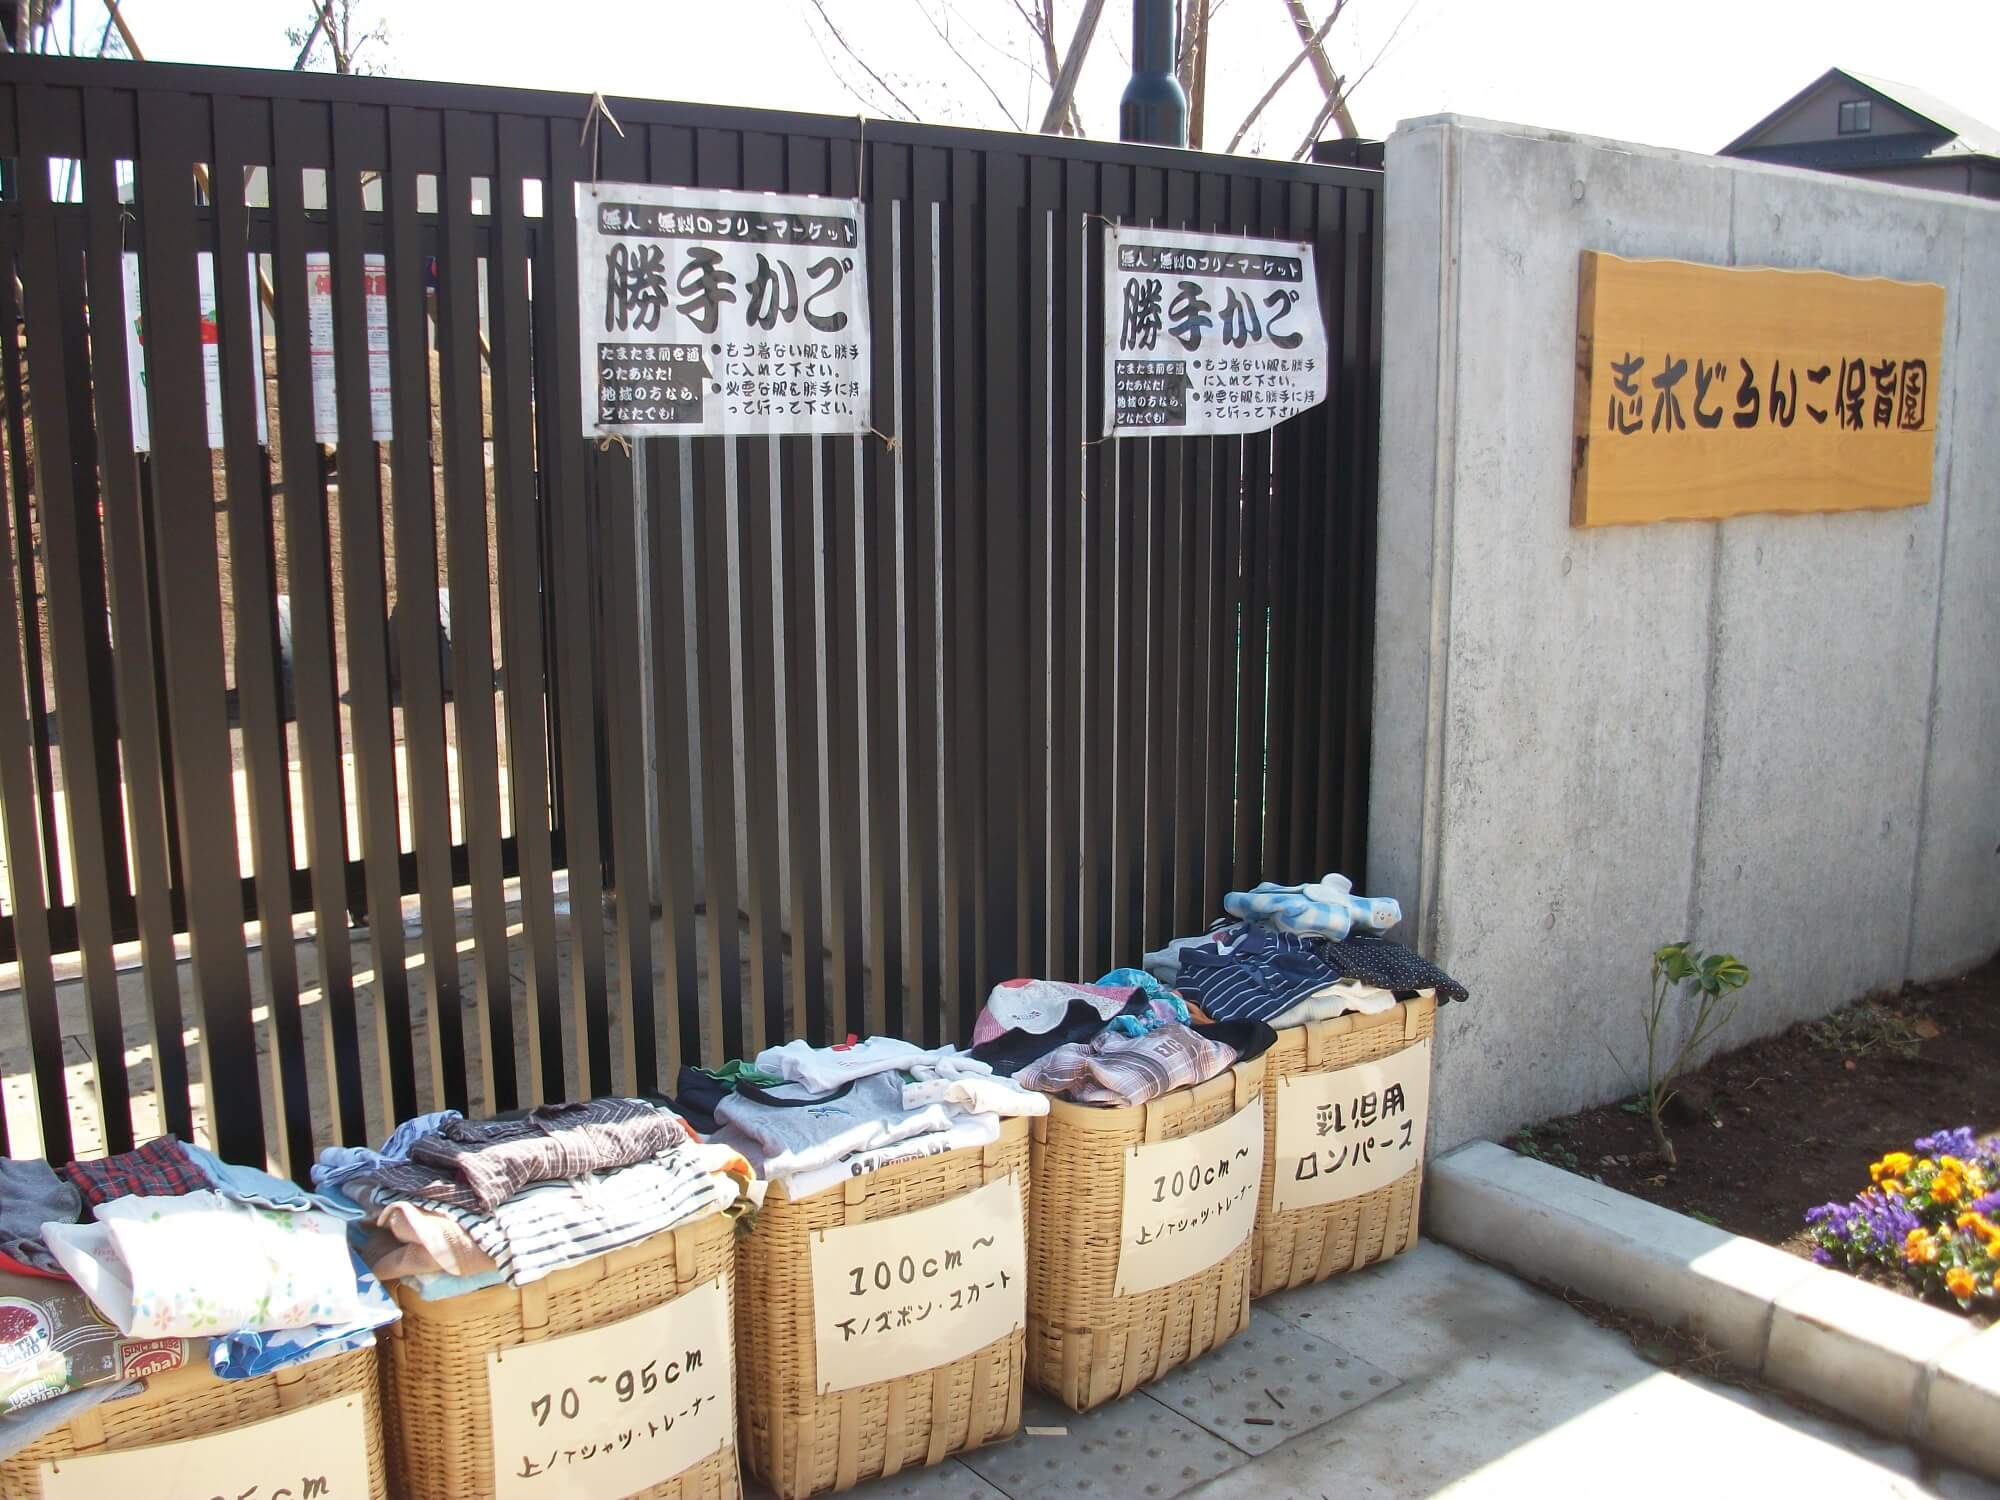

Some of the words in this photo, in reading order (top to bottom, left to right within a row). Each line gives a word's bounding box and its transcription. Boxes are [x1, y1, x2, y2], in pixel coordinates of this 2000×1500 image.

[604, 243, 854, 334] 勝手かご
[1120, 277, 1304, 352] 勝手かご
[1608, 352, 1927, 434] 志木どろんこ保育園
[1315, 1082, 1405, 1137] 乳児用
[1295, 1119, 1413, 1181] ロンパース
[125, 1353, 178, 1379] Global
